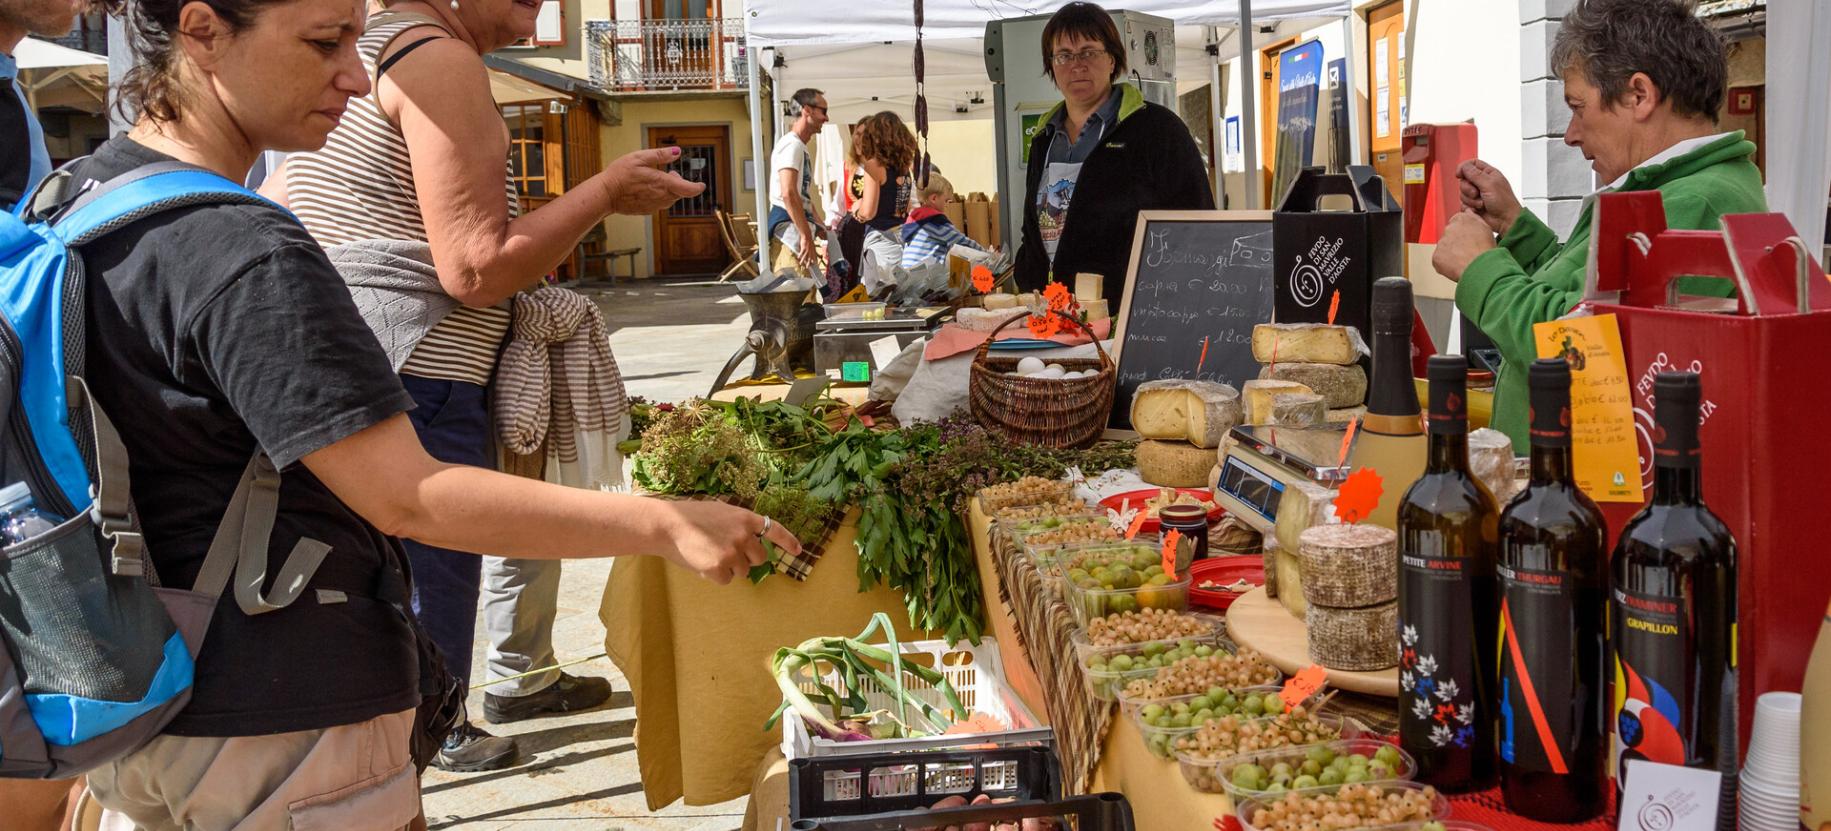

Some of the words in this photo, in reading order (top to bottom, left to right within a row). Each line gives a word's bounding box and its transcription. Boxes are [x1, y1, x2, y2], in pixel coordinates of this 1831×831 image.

[1308, 235, 1326, 259] FEVDO
[1313, 254, 1322, 265] DI
[1320, 241, 1332, 258] SAN
[1318, 237, 1344, 272] MAVRIZIO
[1323, 257, 1340, 277] VALLE
[1328, 256, 1351, 284] D'AOSTA
[1636, 352, 1668, 396] FEVDO
[1402, 554, 1426, 569] PETITE
[1427, 559, 1462, 570] ARVINE
[1517, 571, 1562, 585] THURGAU
[1626, 617, 1678, 635] GRAPILLON
